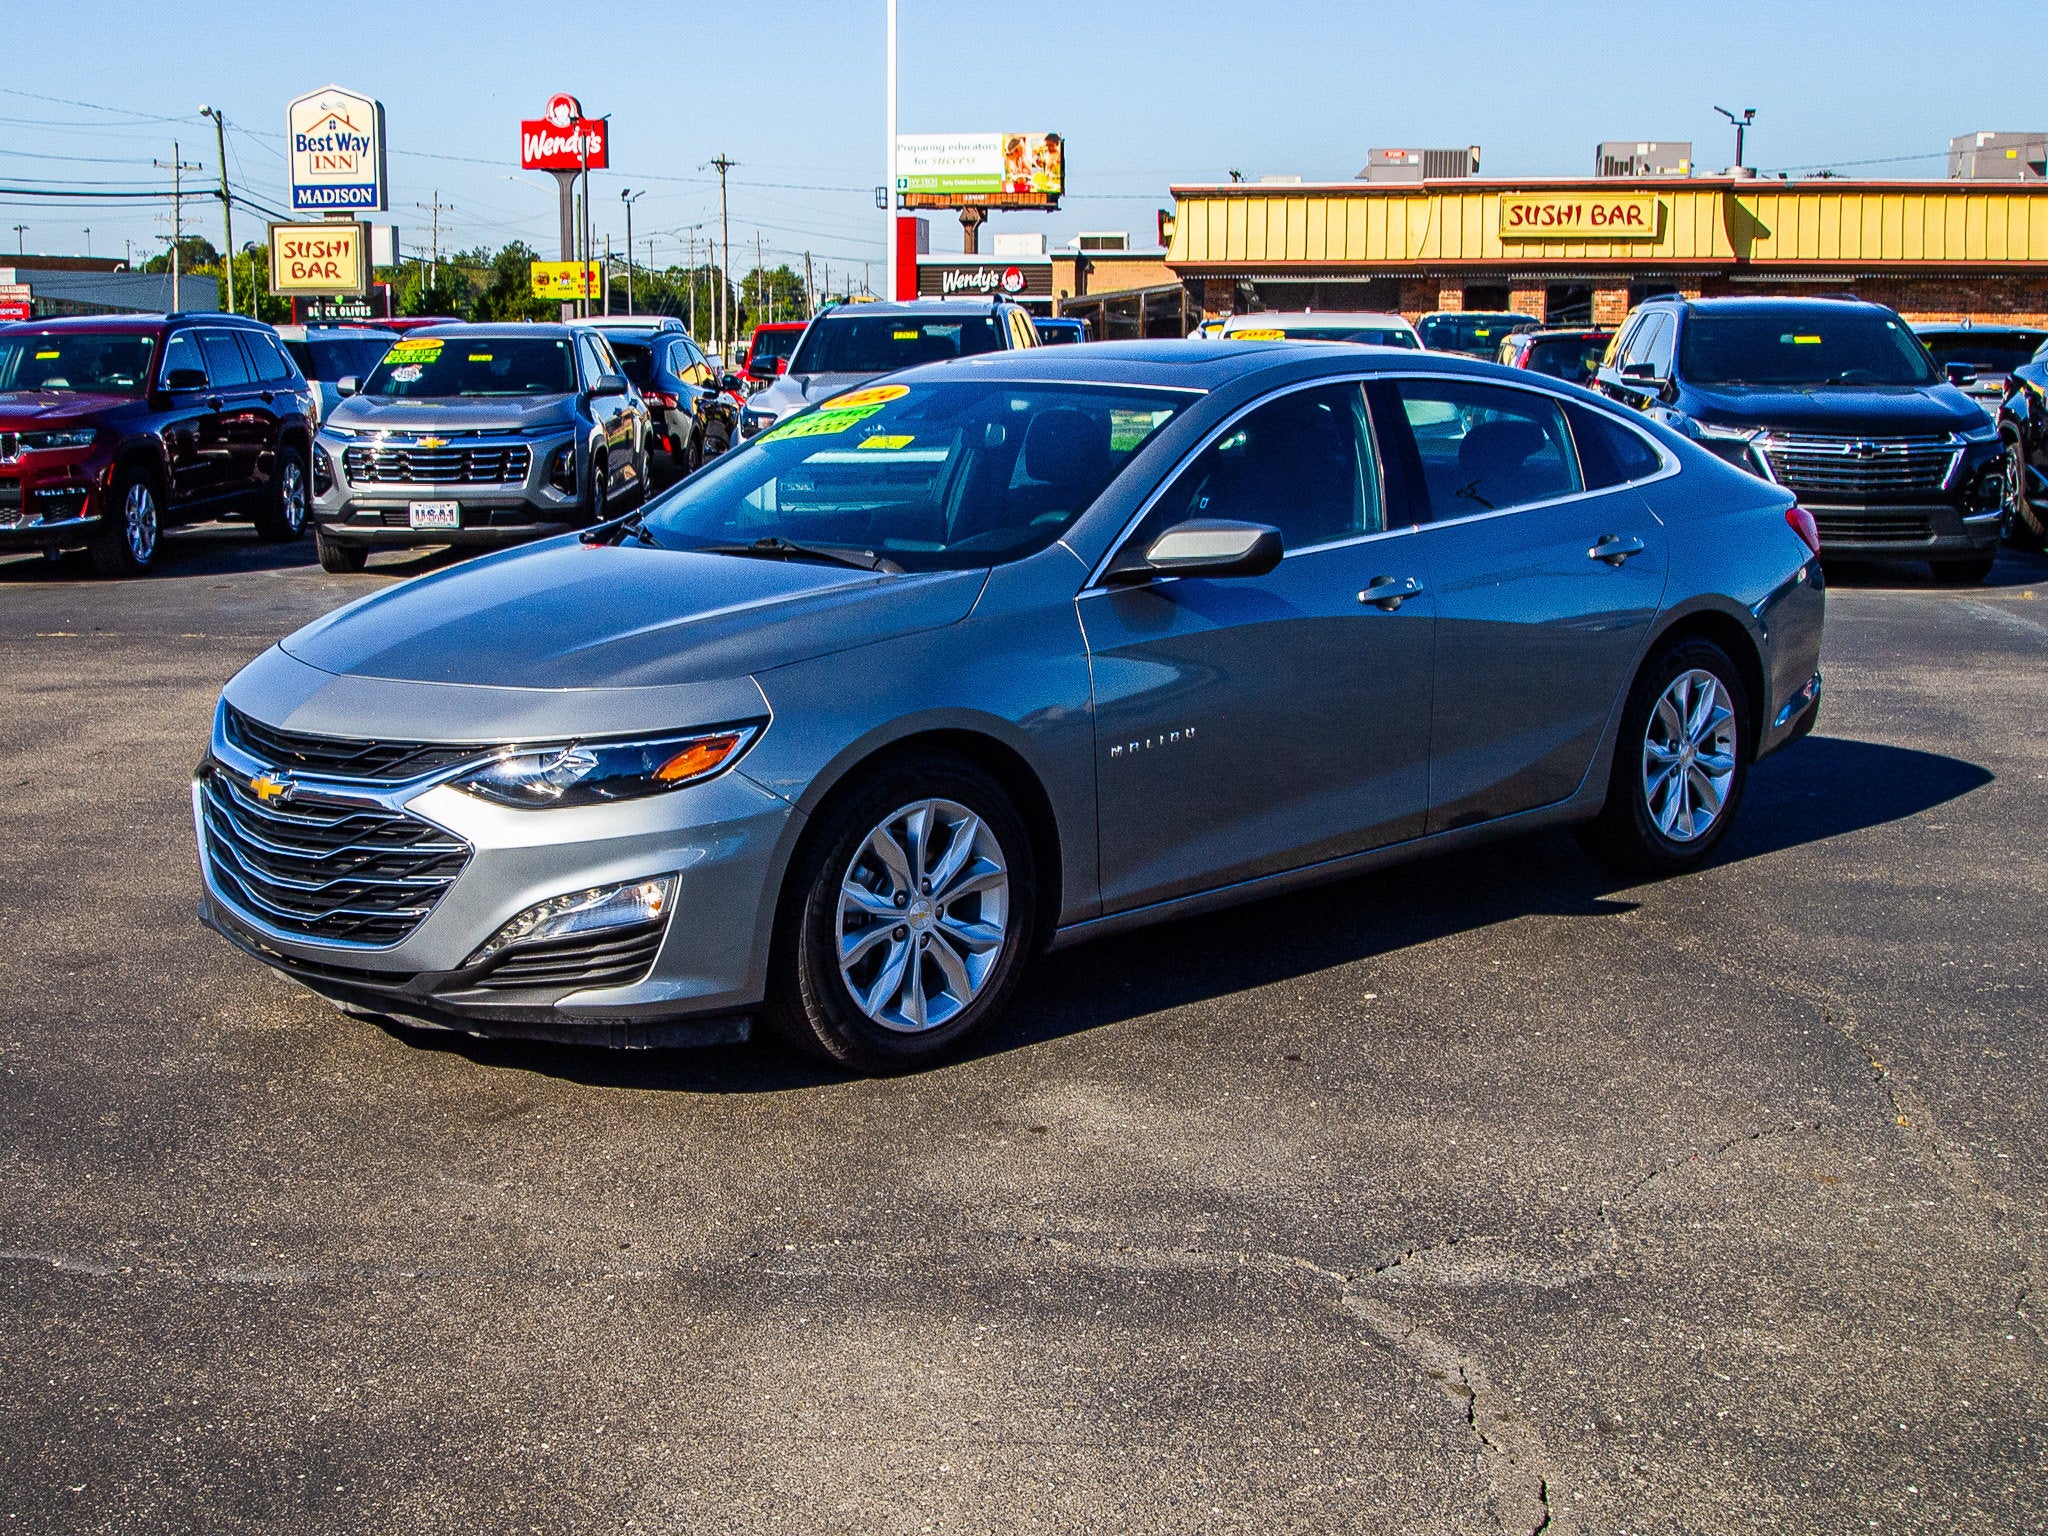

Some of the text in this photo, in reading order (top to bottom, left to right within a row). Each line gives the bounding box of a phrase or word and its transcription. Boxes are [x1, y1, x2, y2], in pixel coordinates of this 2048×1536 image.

[296, 132, 370, 157] Best Way
[524, 125, 602, 163] Wendy's
[897, 142, 998, 153] Preparing educators
[314, 154, 352, 169] INN
[914, 157, 976, 166] for success
[298, 188, 372, 204] MADISON
[1509, 204, 1644, 226] SUSHI BAR
[283, 240, 350, 259] SUSHI
[291, 261, 342, 279] BAR
[942, 266, 1000, 293] Wendy's
[307, 305, 372, 317] BLCK OLIVES
[1111, 727, 1196, 758] MALIBU
